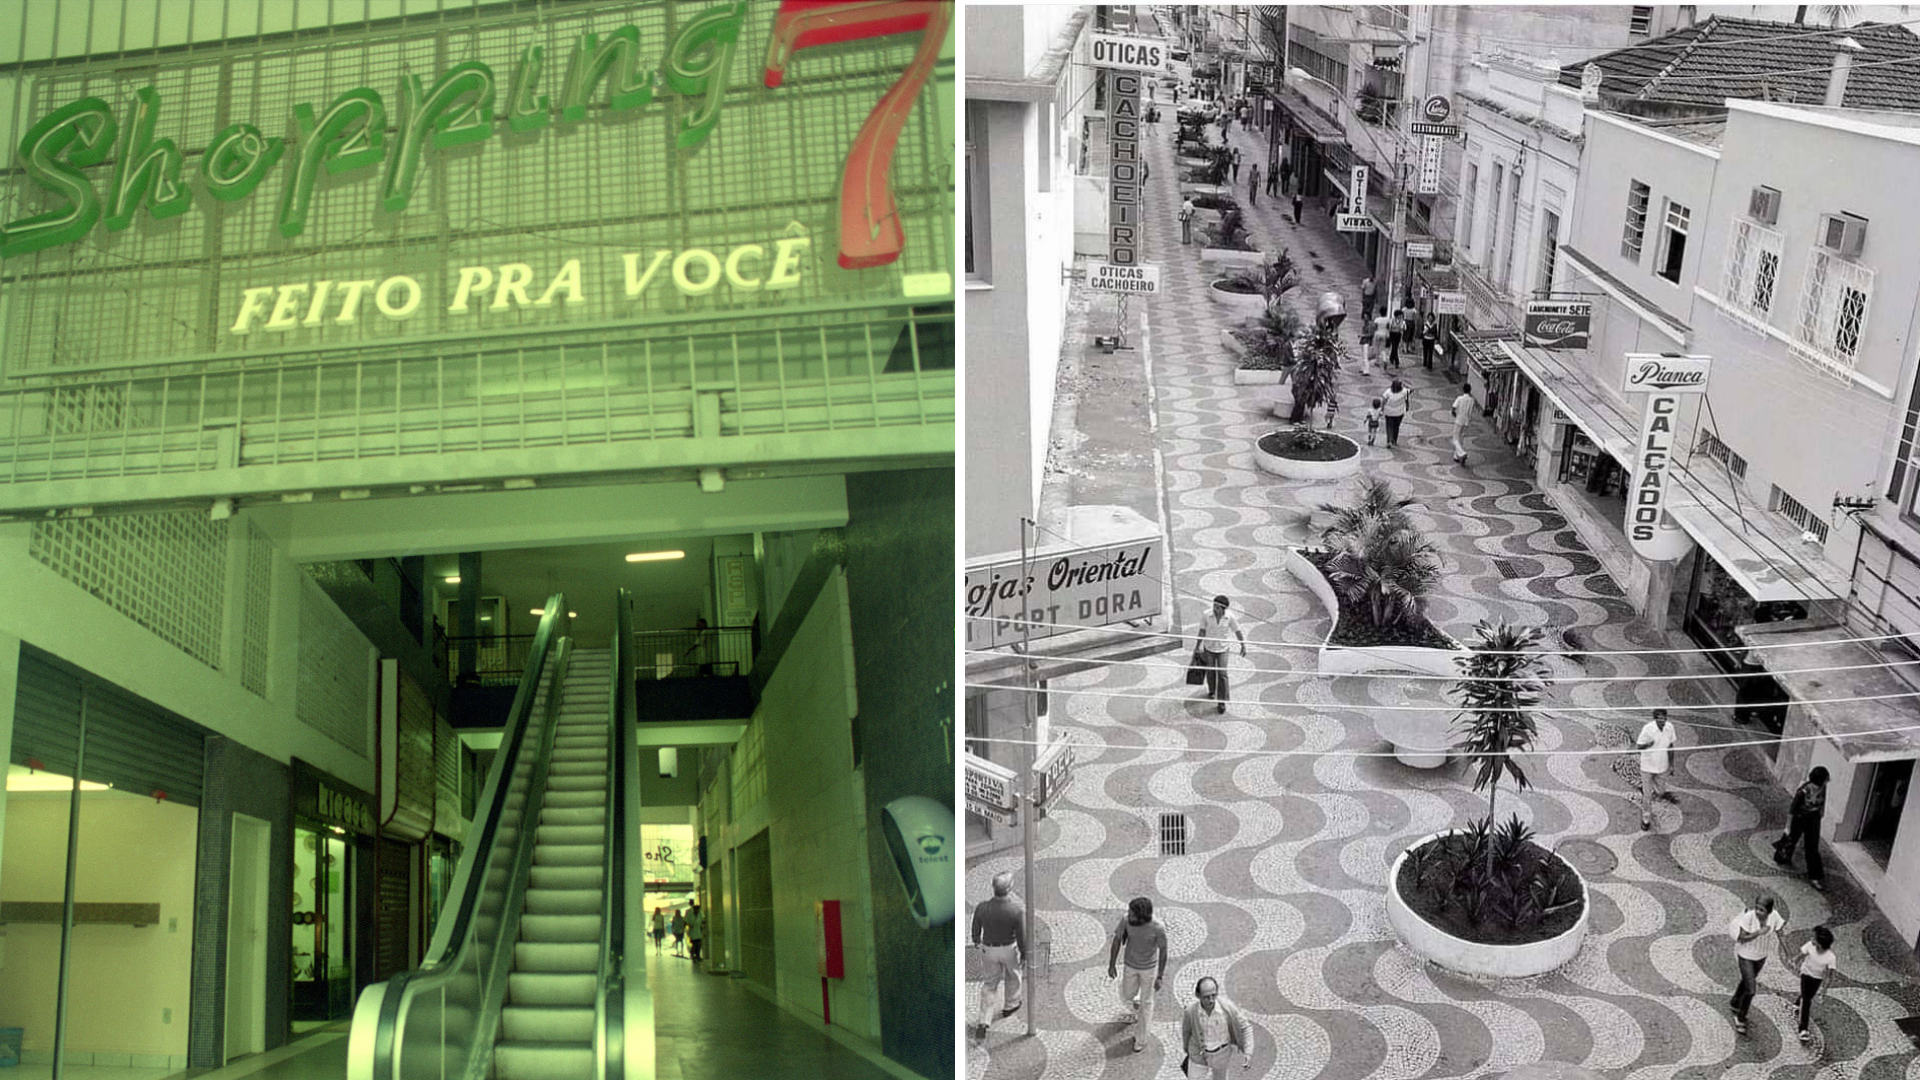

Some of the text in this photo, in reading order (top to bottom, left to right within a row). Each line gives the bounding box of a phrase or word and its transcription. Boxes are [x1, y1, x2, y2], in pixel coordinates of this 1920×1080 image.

[0, 0, 952, 268] Shopping 7
[1113, 76, 1138, 264] CACHOEIRO
[229, 220, 811, 335] FEITO PRA VOCÊ
[1091, 277, 1155, 292] CACHOEIRO
[1100, 266, 1144, 279] OTICAS
[1568, 304, 1591, 315] SETE
[1630, 361, 1706, 388] Pianca
[965, 547, 1151, 617] ojas Oriental
[1079, 590, 1142, 620] DORA
